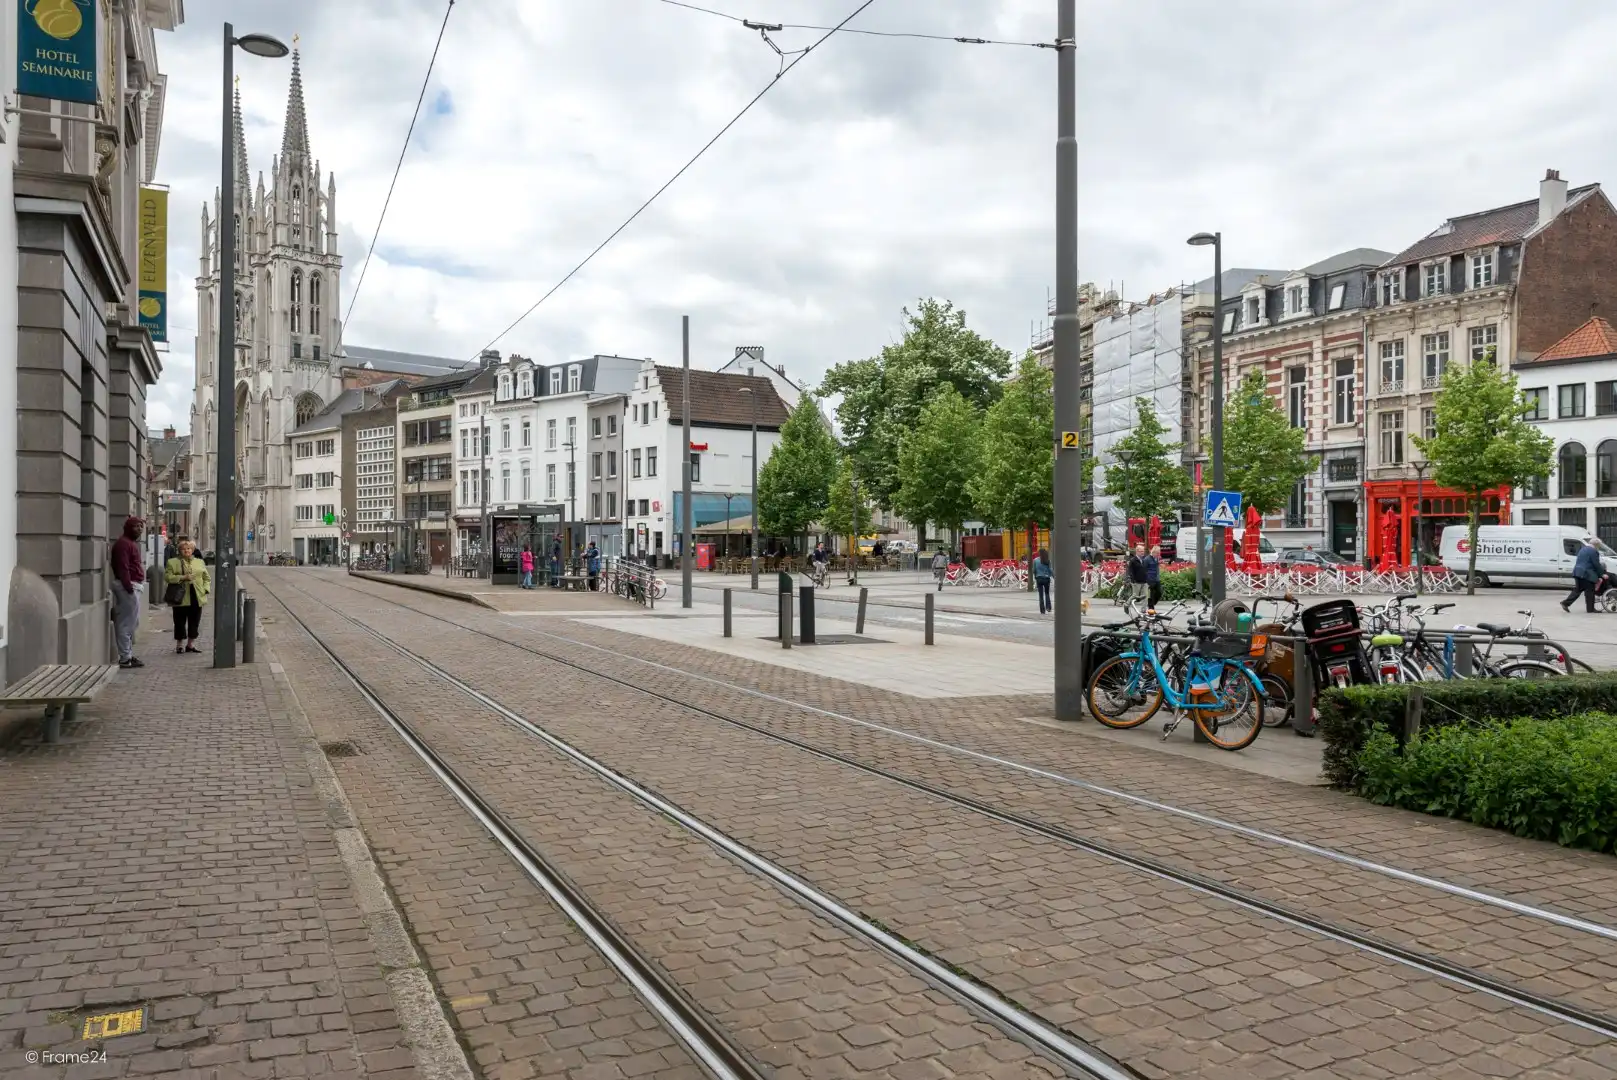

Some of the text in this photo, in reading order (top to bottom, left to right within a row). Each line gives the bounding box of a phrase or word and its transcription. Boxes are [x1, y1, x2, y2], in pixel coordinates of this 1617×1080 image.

[36, 48, 80, 64] HOTEL
[22, 61, 93, 81] SEMINARIE
[144, 199, 156, 282] ELZENVELD
[1065, 432, 1076, 447] 2
[1476, 544, 1531, 554] Ghielens
